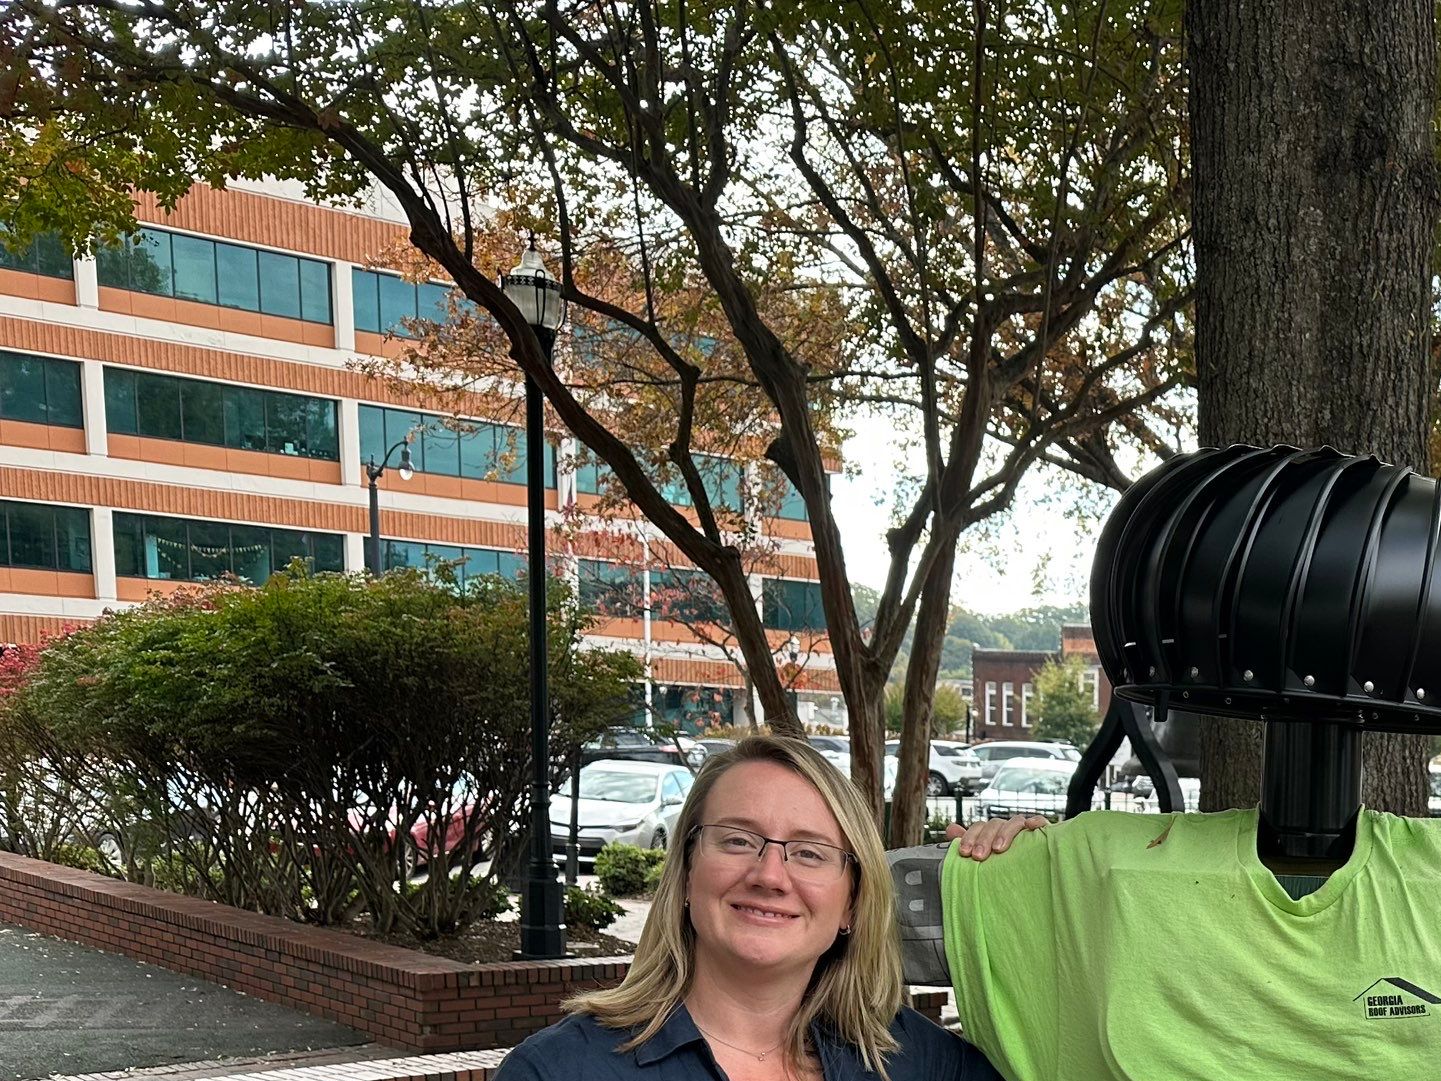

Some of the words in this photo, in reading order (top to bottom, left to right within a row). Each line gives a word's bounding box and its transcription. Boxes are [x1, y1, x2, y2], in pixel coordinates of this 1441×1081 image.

[1367, 995, 1403, 1006] GEORGIA
[1368, 1006, 1387, 1016] ROOF
[1390, 1004, 1426, 1016] ADVISORS
